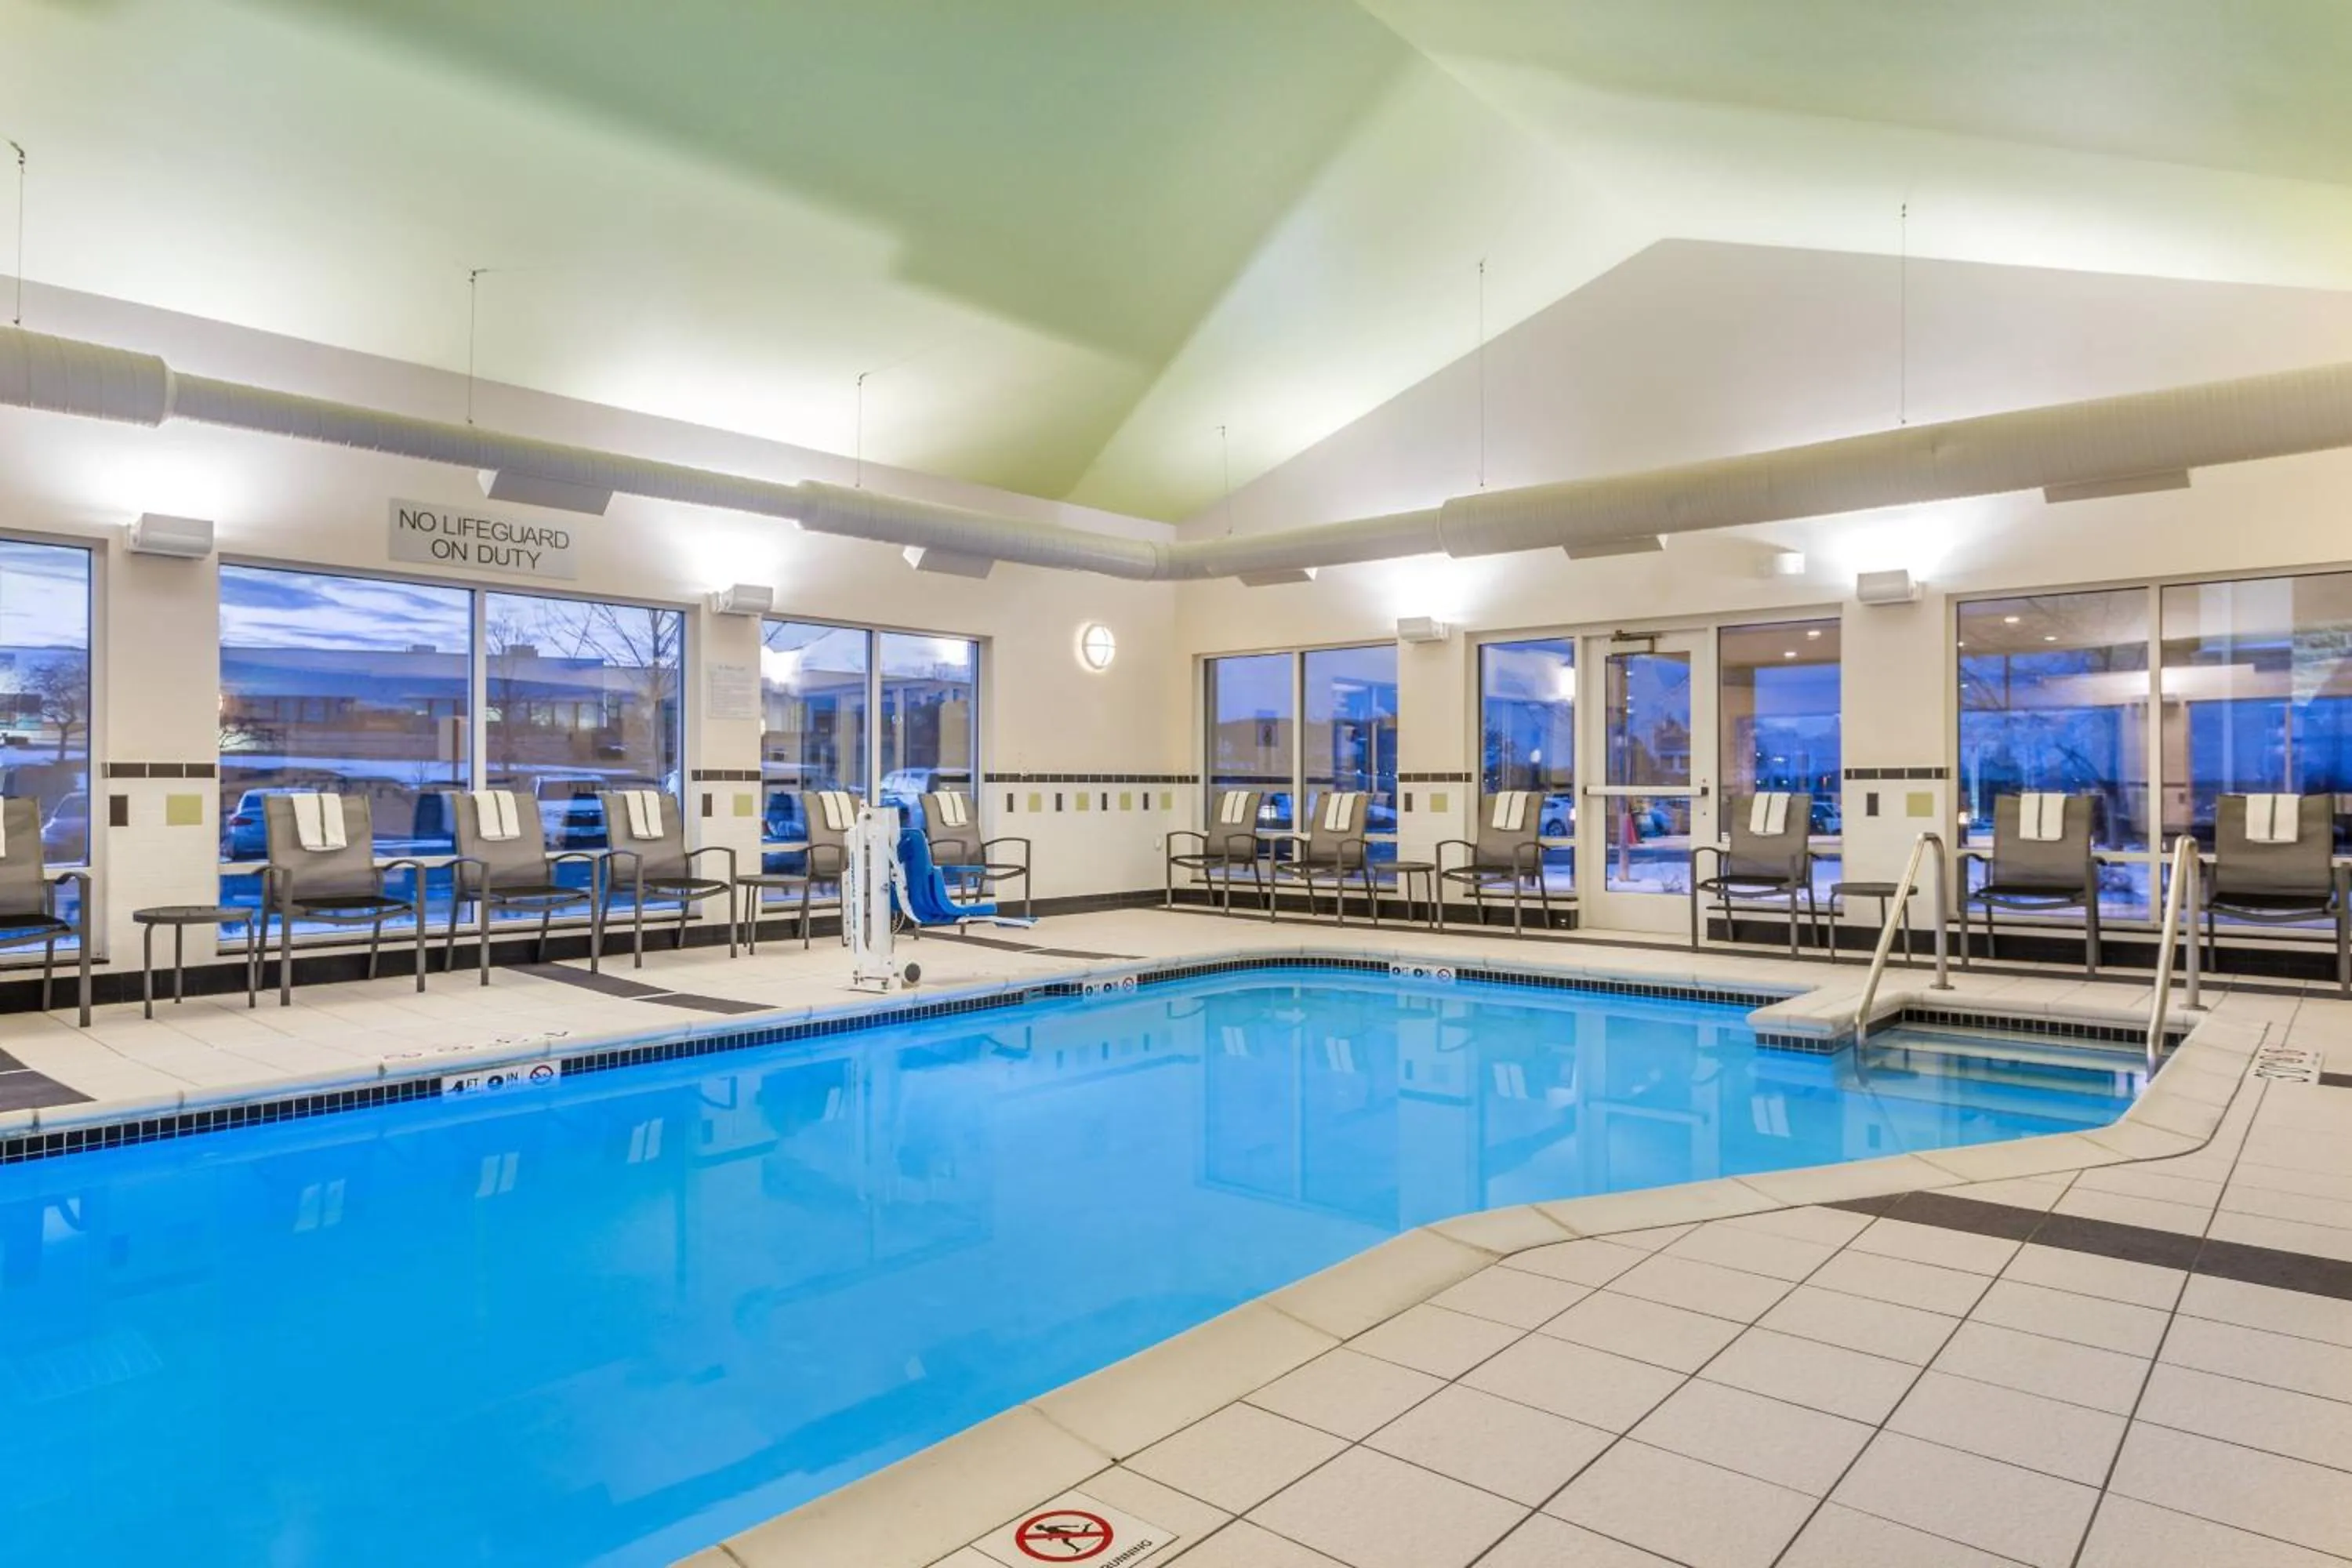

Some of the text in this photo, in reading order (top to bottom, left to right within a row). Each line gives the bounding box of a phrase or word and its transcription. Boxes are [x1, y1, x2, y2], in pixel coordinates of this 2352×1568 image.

[399, 508, 570, 550] NO LIFEGUARD
[432, 539, 542, 571] ON DUTY
